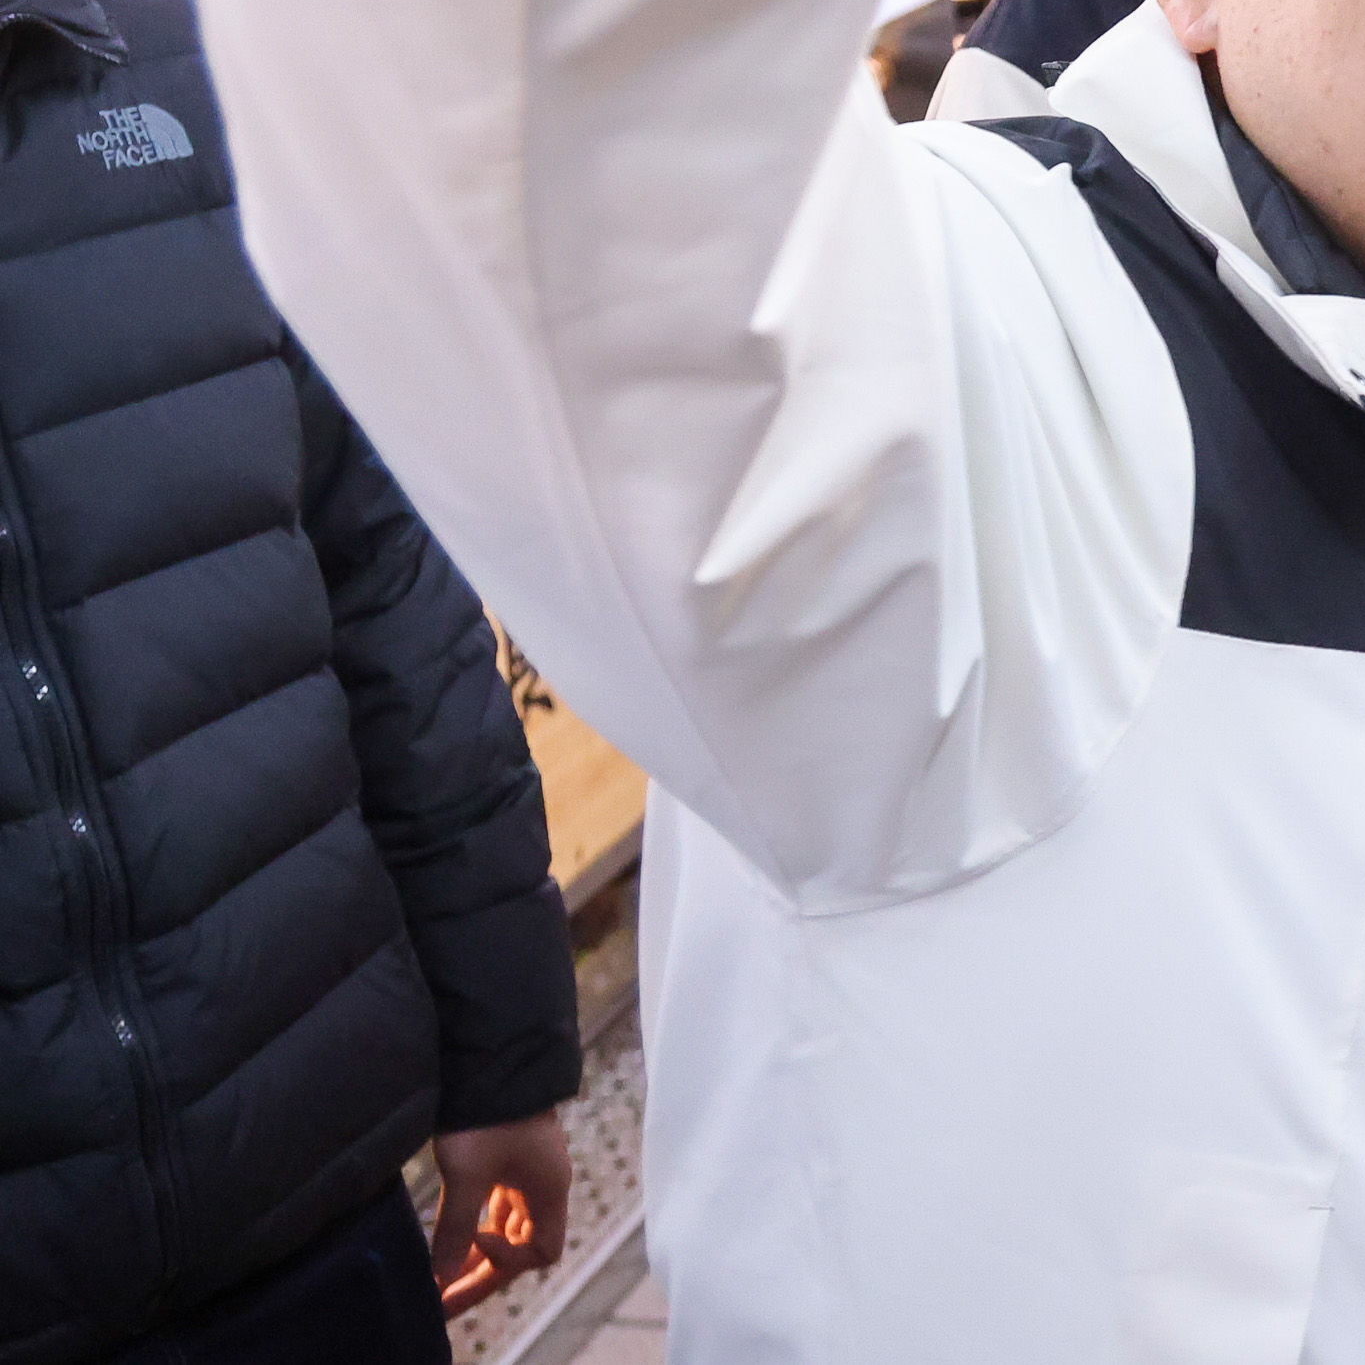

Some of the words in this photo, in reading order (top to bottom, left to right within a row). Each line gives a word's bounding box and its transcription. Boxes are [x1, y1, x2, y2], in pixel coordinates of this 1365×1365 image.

[99, 106, 142, 128] THE
[76, 121, 150, 154] NORTH
[103, 144, 159, 170] FACE
